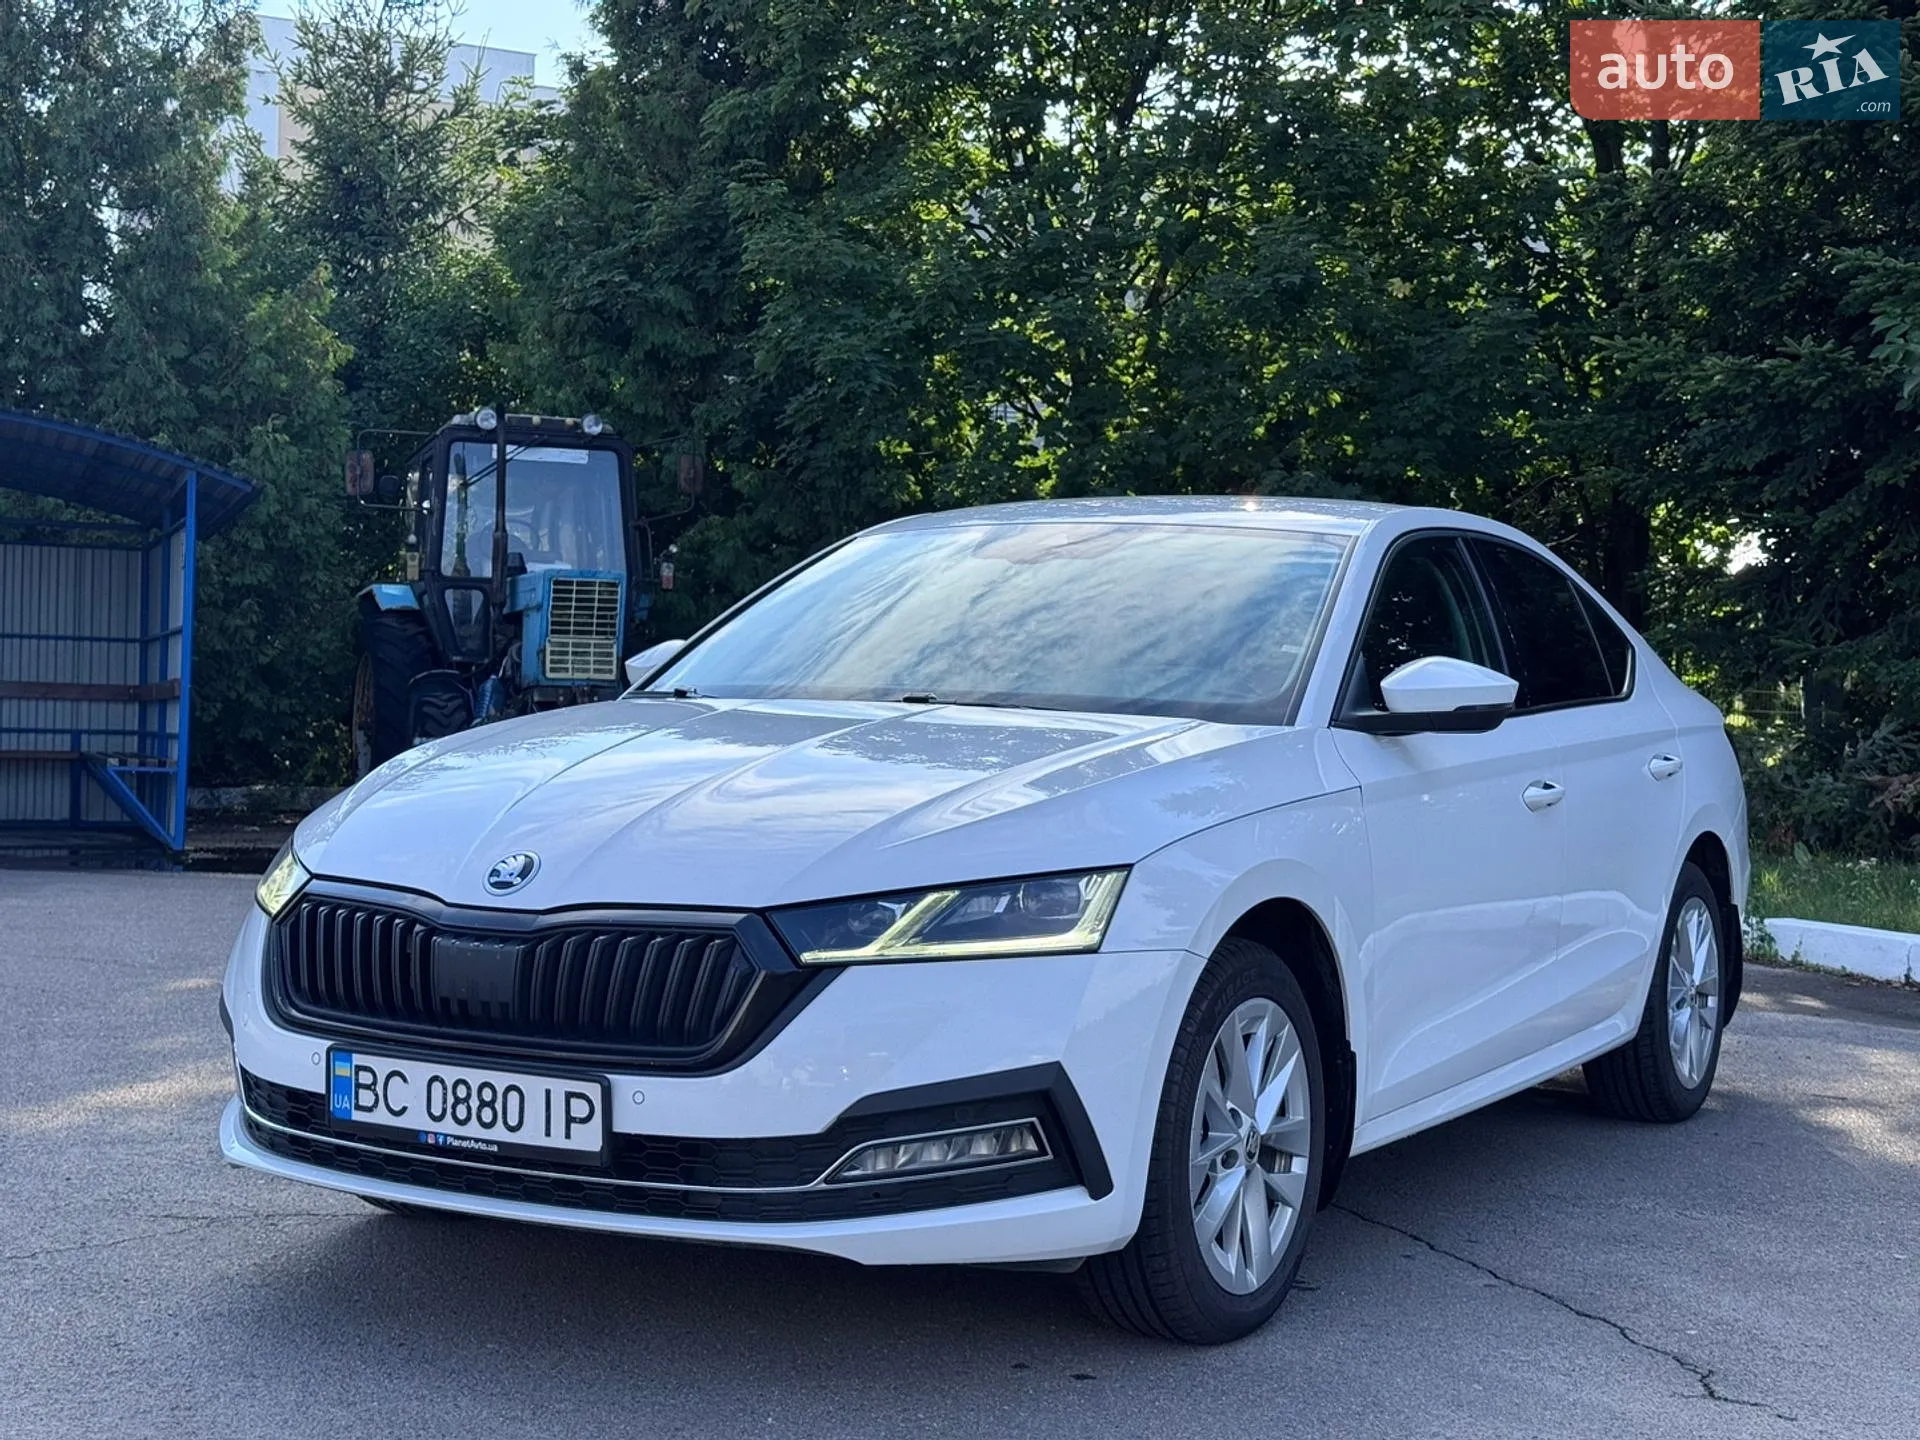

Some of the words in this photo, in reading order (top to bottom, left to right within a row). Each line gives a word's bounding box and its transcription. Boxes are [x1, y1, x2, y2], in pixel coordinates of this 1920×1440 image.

[334, 1093, 351, 1110] UA
[354, 1065, 409, 1118] BC
[426, 1075, 525, 1133] 0880
[545, 1088, 596, 1140] IP
